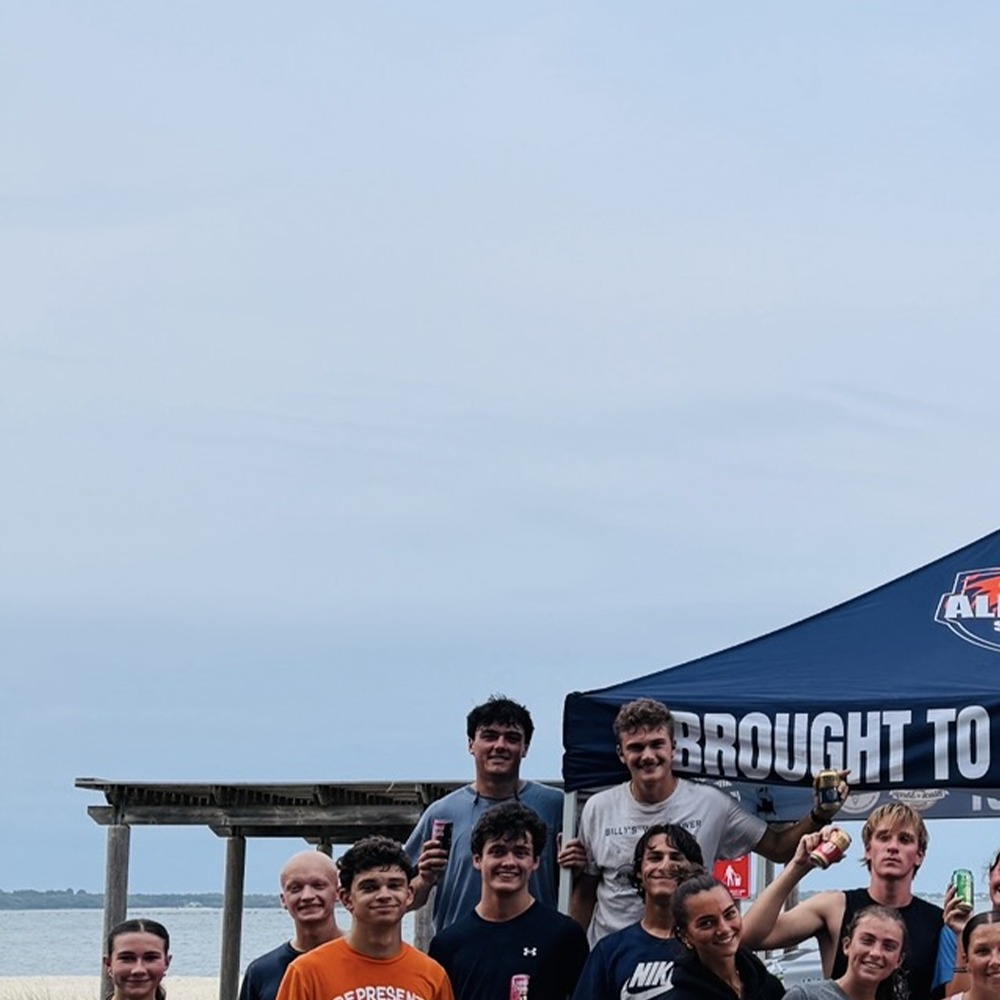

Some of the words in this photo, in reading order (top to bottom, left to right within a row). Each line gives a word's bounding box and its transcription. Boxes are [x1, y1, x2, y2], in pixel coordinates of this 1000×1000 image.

[670, 709, 912, 784] BROUGHT
[926, 705, 991, 780] TO
[628, 961, 674, 988] NIK
